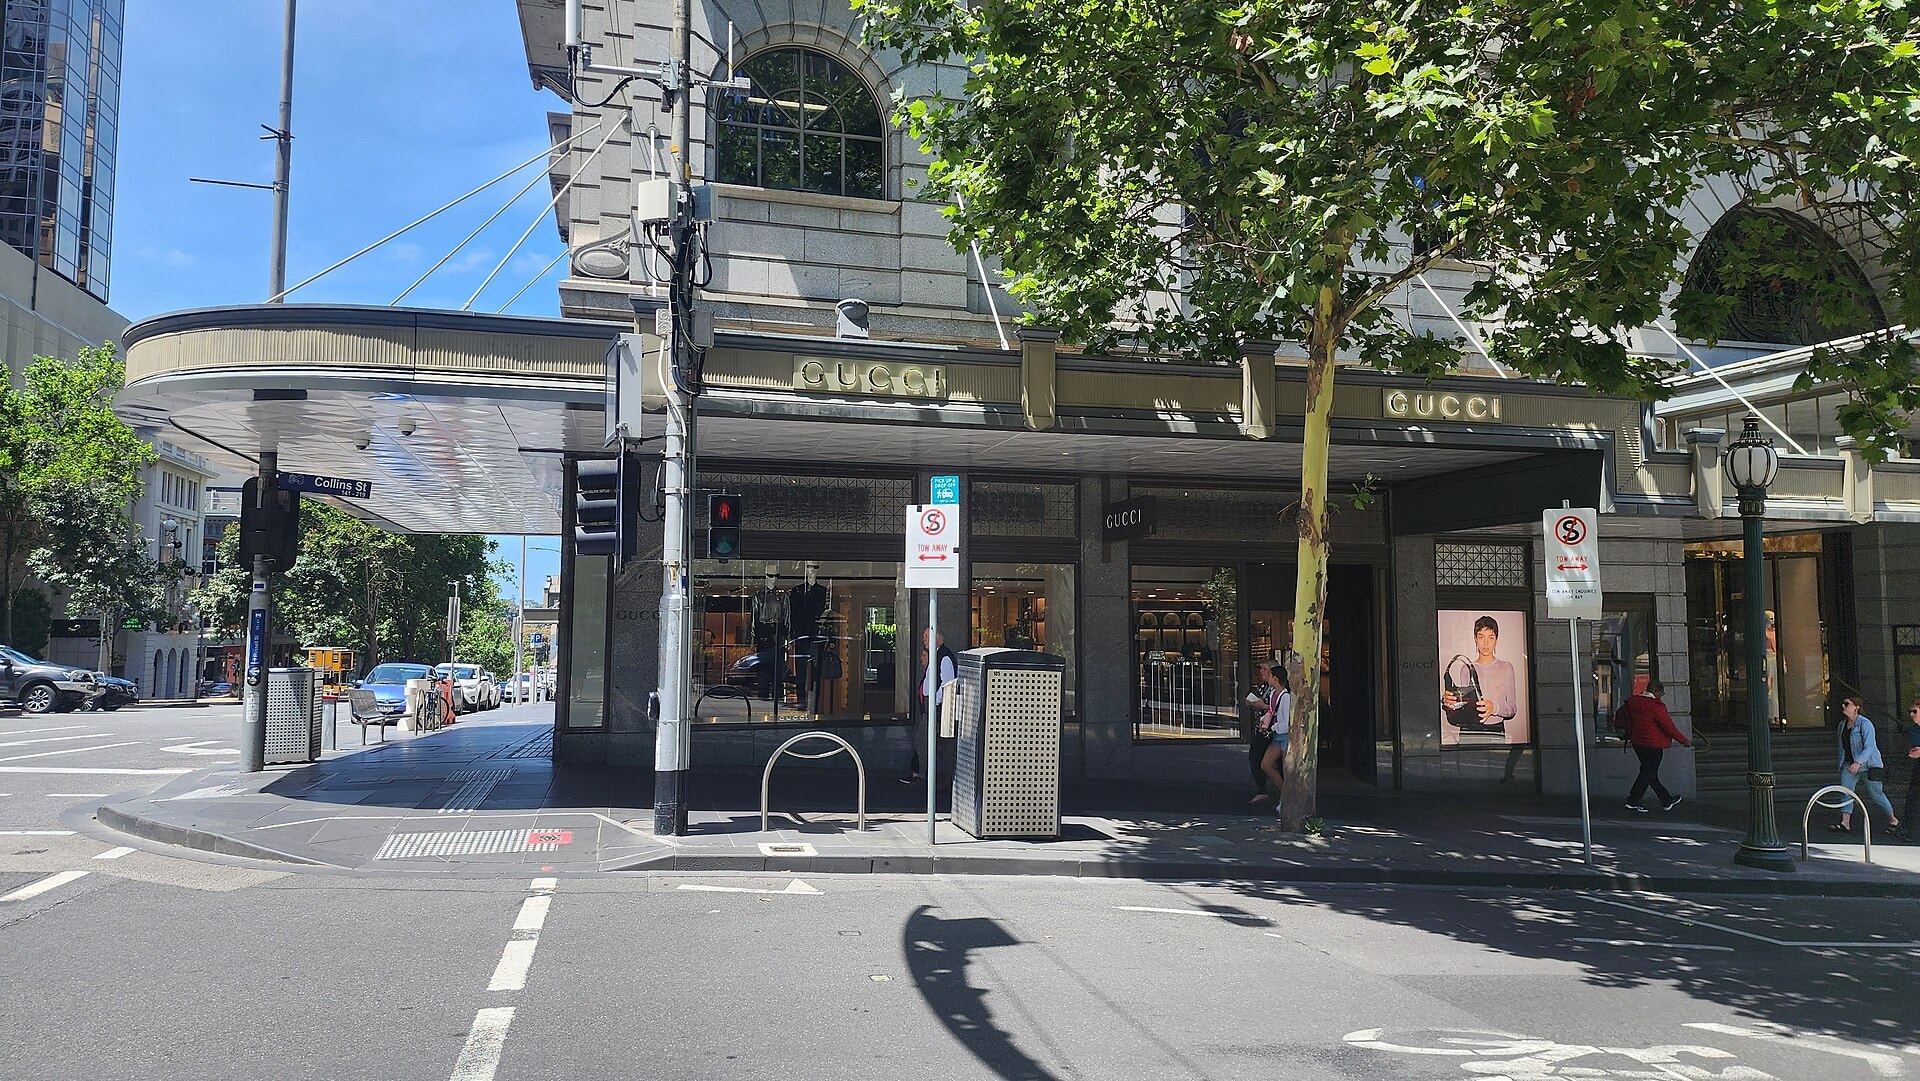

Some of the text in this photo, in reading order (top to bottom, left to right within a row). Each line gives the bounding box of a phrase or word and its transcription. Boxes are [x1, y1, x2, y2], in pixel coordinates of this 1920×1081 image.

[801, 360, 942, 393] GUCCI
[1387, 391, 1500, 420] GUCCI
[314, 476, 368, 493] Collins St
[1106, 508, 1141, 529] GUCCI
[918, 544, 948, 552] TOW AWAY
